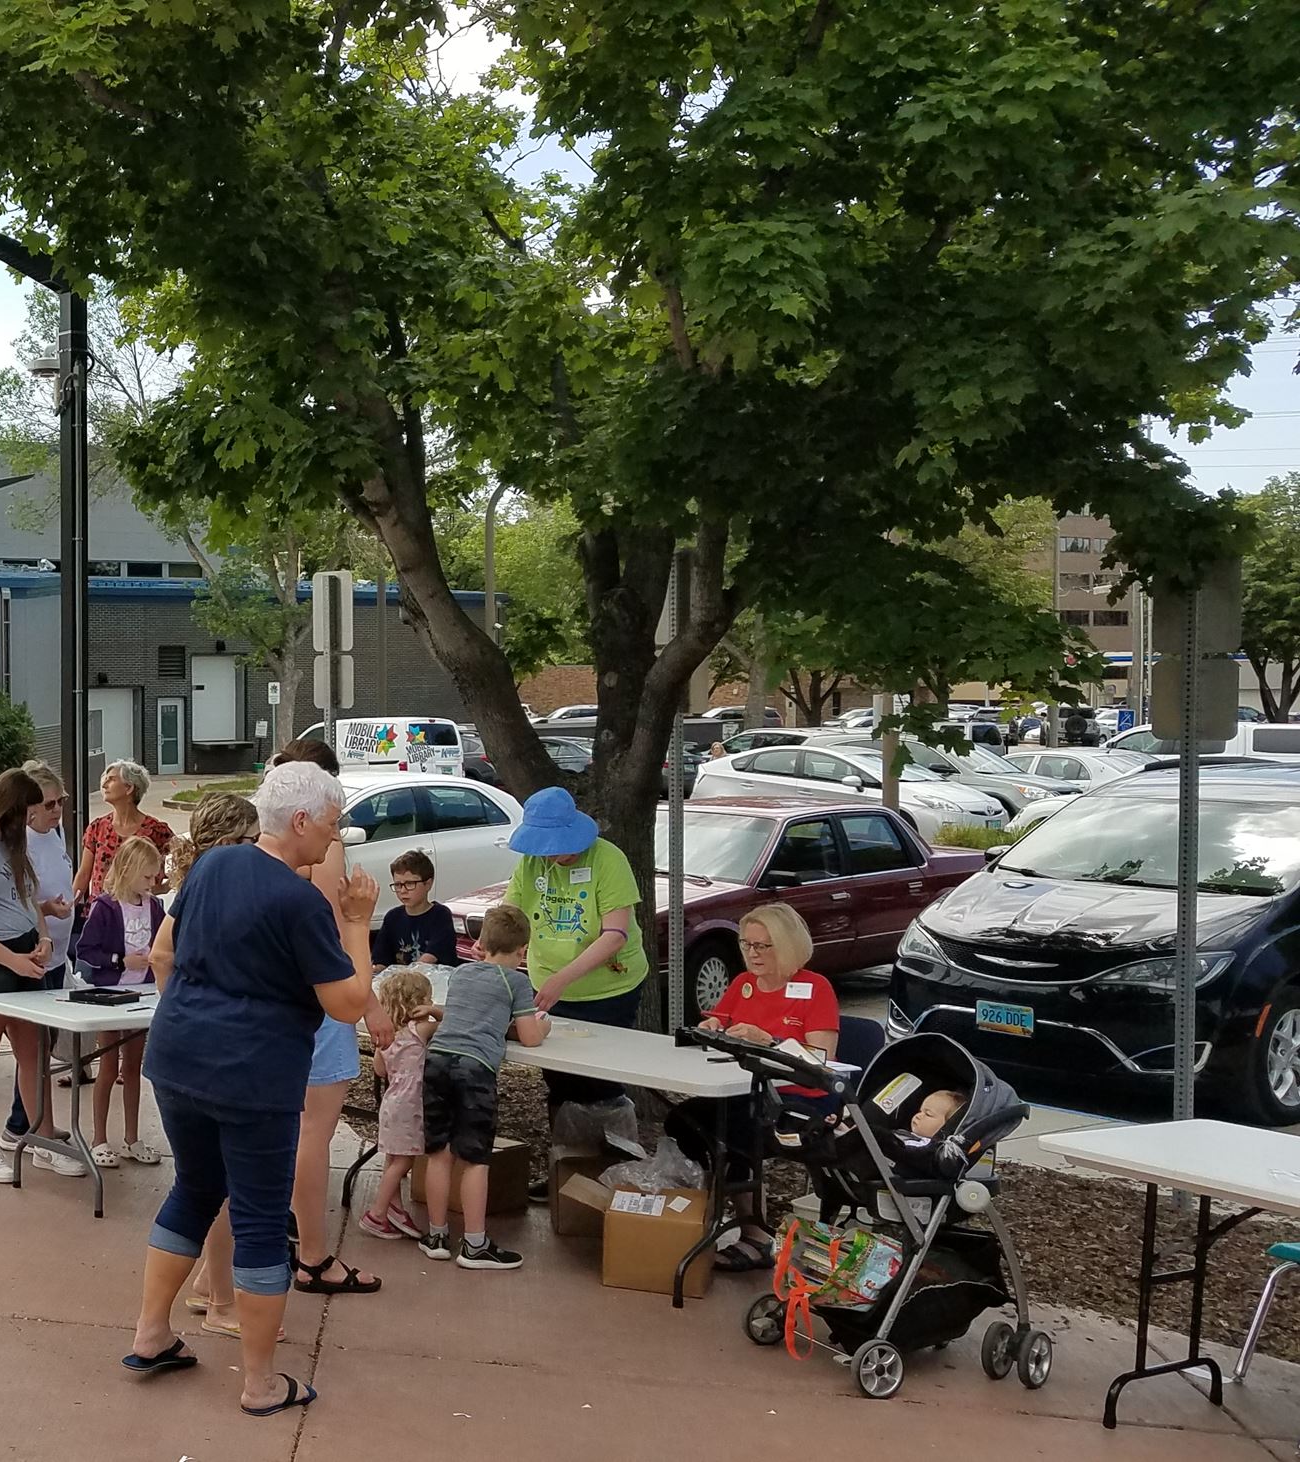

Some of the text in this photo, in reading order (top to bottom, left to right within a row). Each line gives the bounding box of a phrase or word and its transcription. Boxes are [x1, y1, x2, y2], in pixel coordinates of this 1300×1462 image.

[347, 722, 380, 738] MOBILE
[344, 736, 382, 754] LIBRARY
[406, 743, 430, 754] MOBILE
[406, 747, 436, 764] LIBRARY
[981, 1008, 1002, 1024] 926
[1006, 1012, 1028, 1028] DDE
